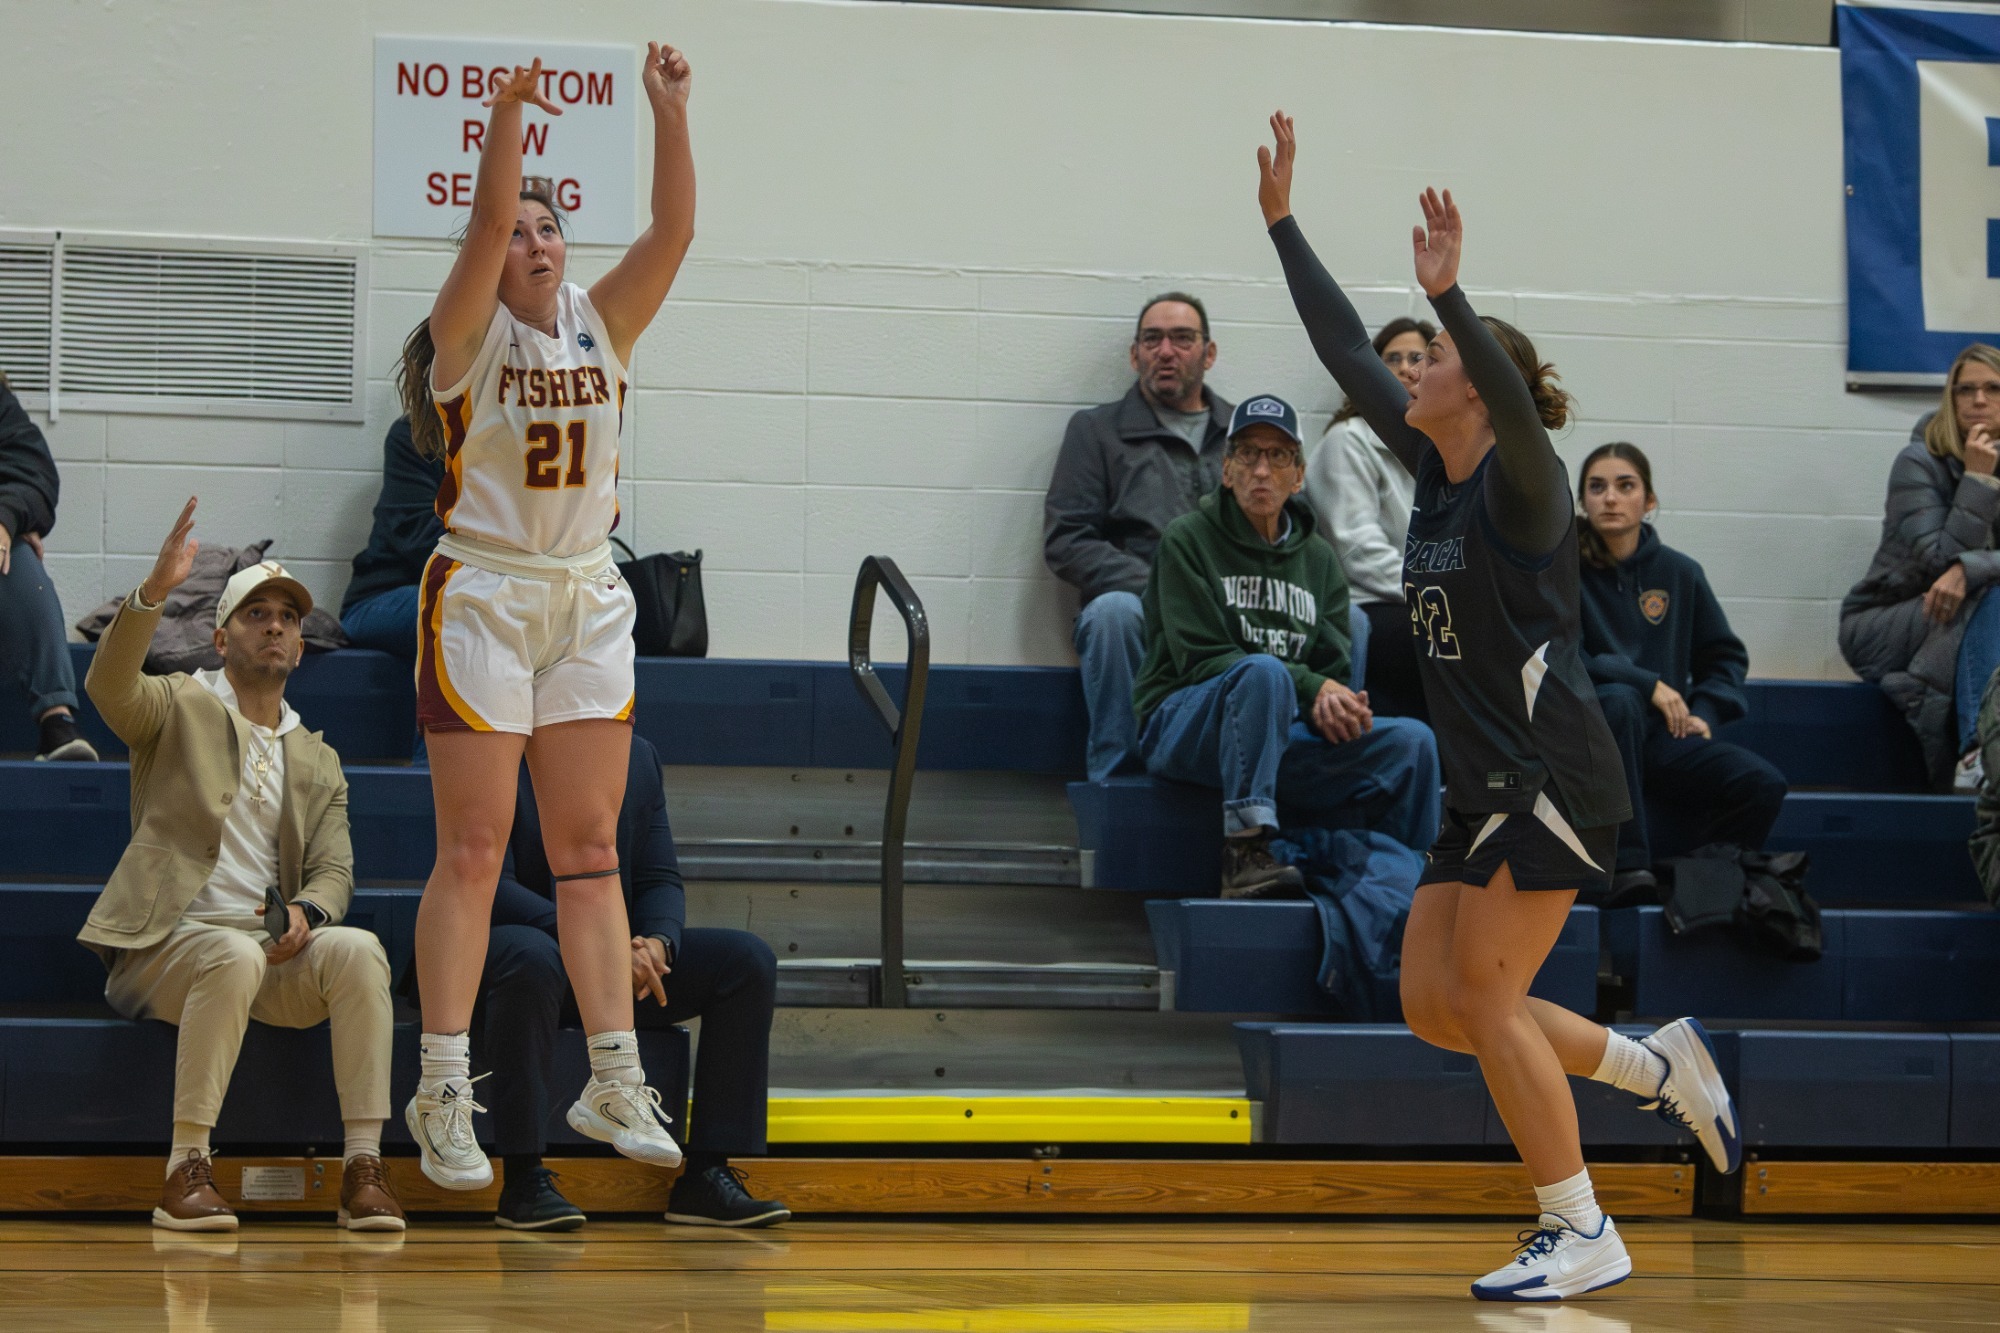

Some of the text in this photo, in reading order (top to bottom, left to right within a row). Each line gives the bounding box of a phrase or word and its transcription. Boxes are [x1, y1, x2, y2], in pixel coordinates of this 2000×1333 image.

[397, 62, 613, 106] NO BOTOM
[463, 120, 548, 156] RW
[498, 364, 610, 408] FISHER
[523, 418, 587, 490] 21
